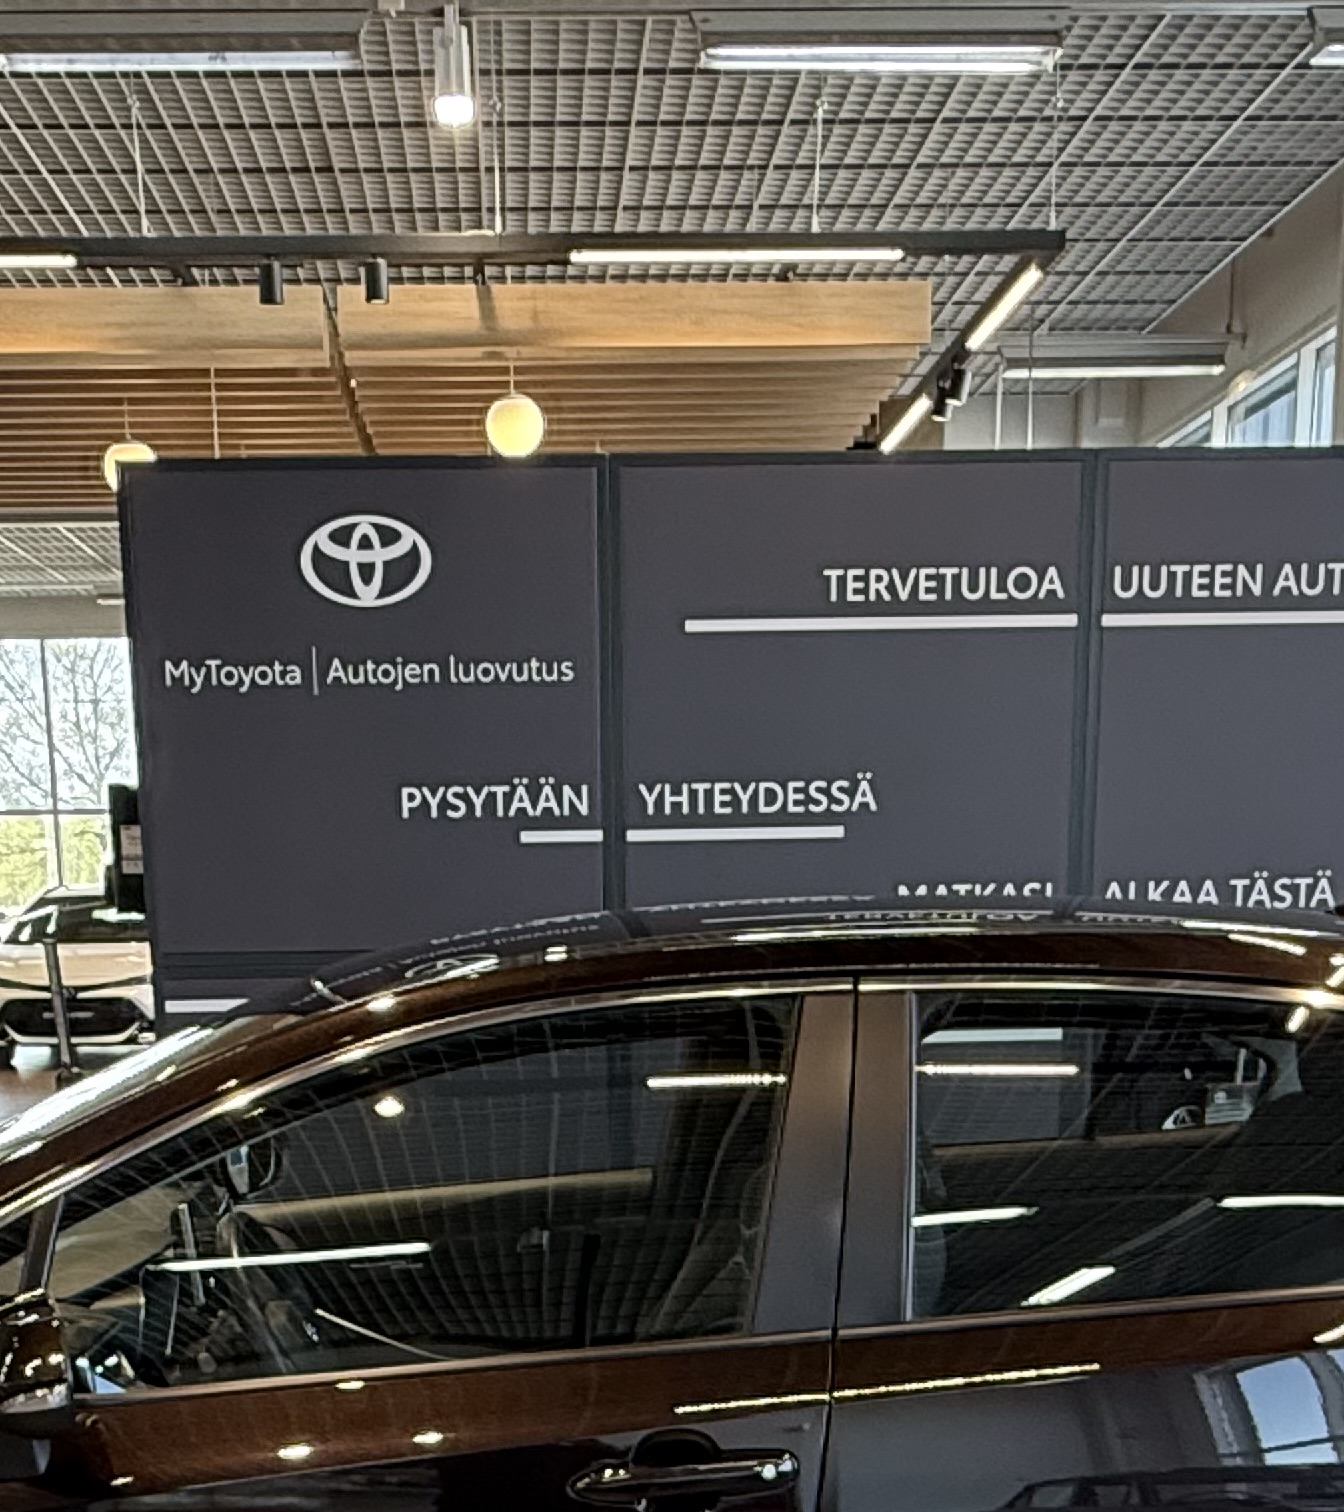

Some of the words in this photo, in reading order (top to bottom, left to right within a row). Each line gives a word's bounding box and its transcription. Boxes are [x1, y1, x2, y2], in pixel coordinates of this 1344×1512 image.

[822, 567, 1066, 603] TERVETULOA
[1113, 563, 1265, 600] UUTEEN
[163, 659, 303, 694] MyToyota
[326, 656, 441, 691] Autojen
[449, 654, 576, 685] luovutus
[400, 777, 590, 819] PYSYTÄÄN
[638, 771, 879, 816] YHTEYDESSÄ
[1229, 868, 1336, 910] TÄSTÄ
